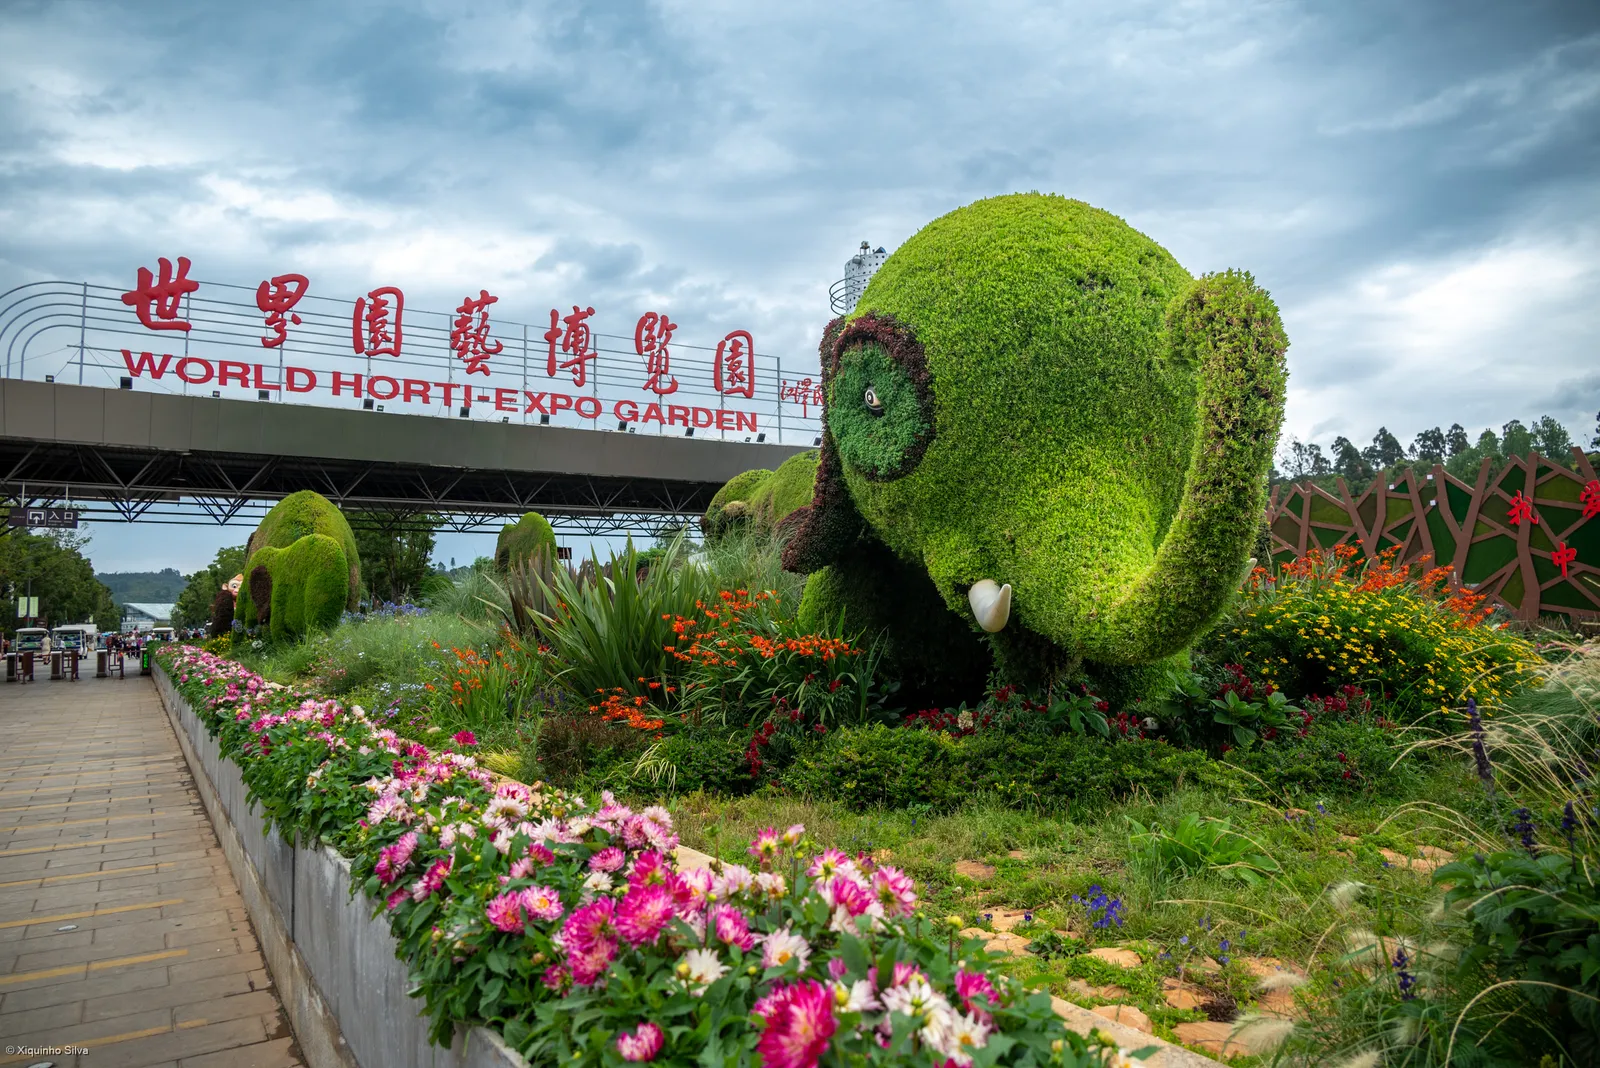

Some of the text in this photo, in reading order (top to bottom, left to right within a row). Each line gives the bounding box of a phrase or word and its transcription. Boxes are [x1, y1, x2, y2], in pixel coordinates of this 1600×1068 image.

[121, 349, 758, 433] WORLD HORTI-EXPO GARDEN
[49, 510, 74, 520] 入口
[1550, 541, 1577, 578] 中
